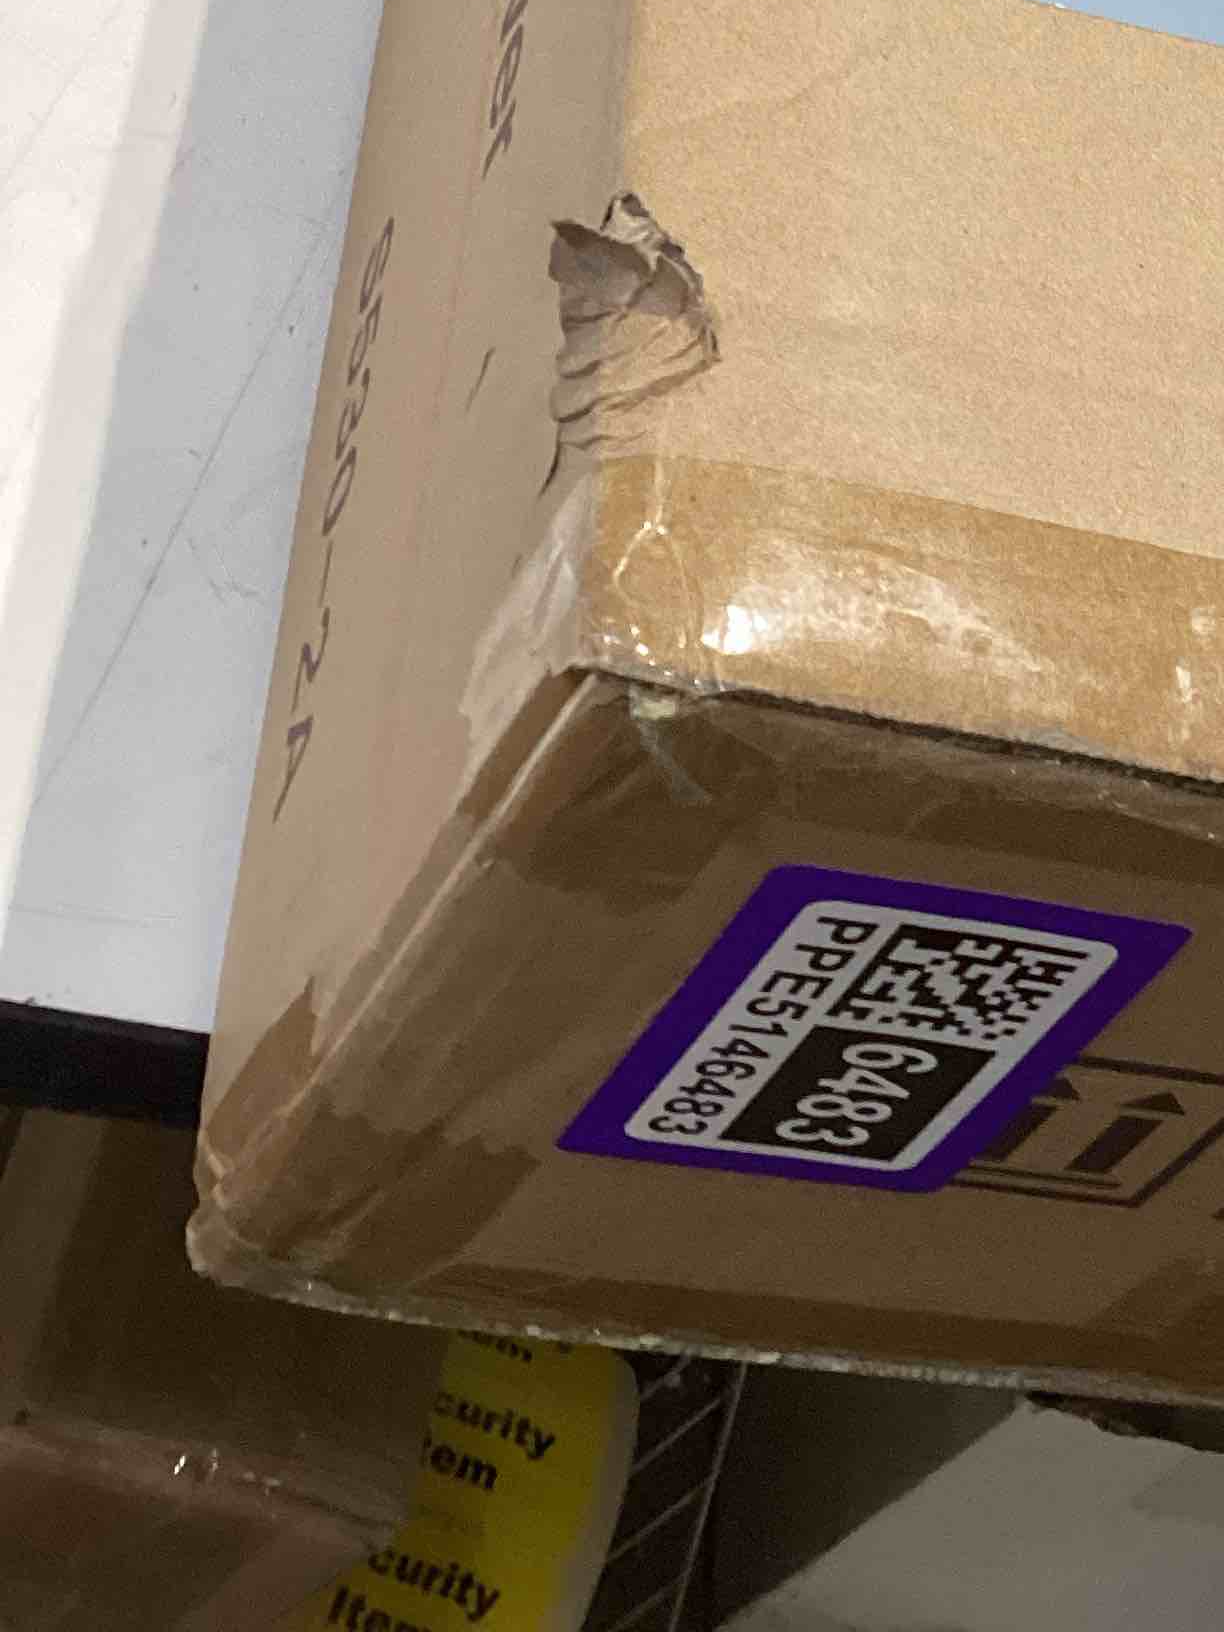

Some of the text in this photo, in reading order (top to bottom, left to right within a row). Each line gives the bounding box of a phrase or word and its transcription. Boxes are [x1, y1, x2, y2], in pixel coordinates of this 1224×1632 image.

[271, 215, 396, 824] S530-2A
[647, 915, 879, 1138] PPE5146483
[774, 1041, 940, 1148] 6483
[424, 1434, 499, 1491] em
[434, 1391, 556, 1462] curity
[367, 1547, 501, 1623] curity
